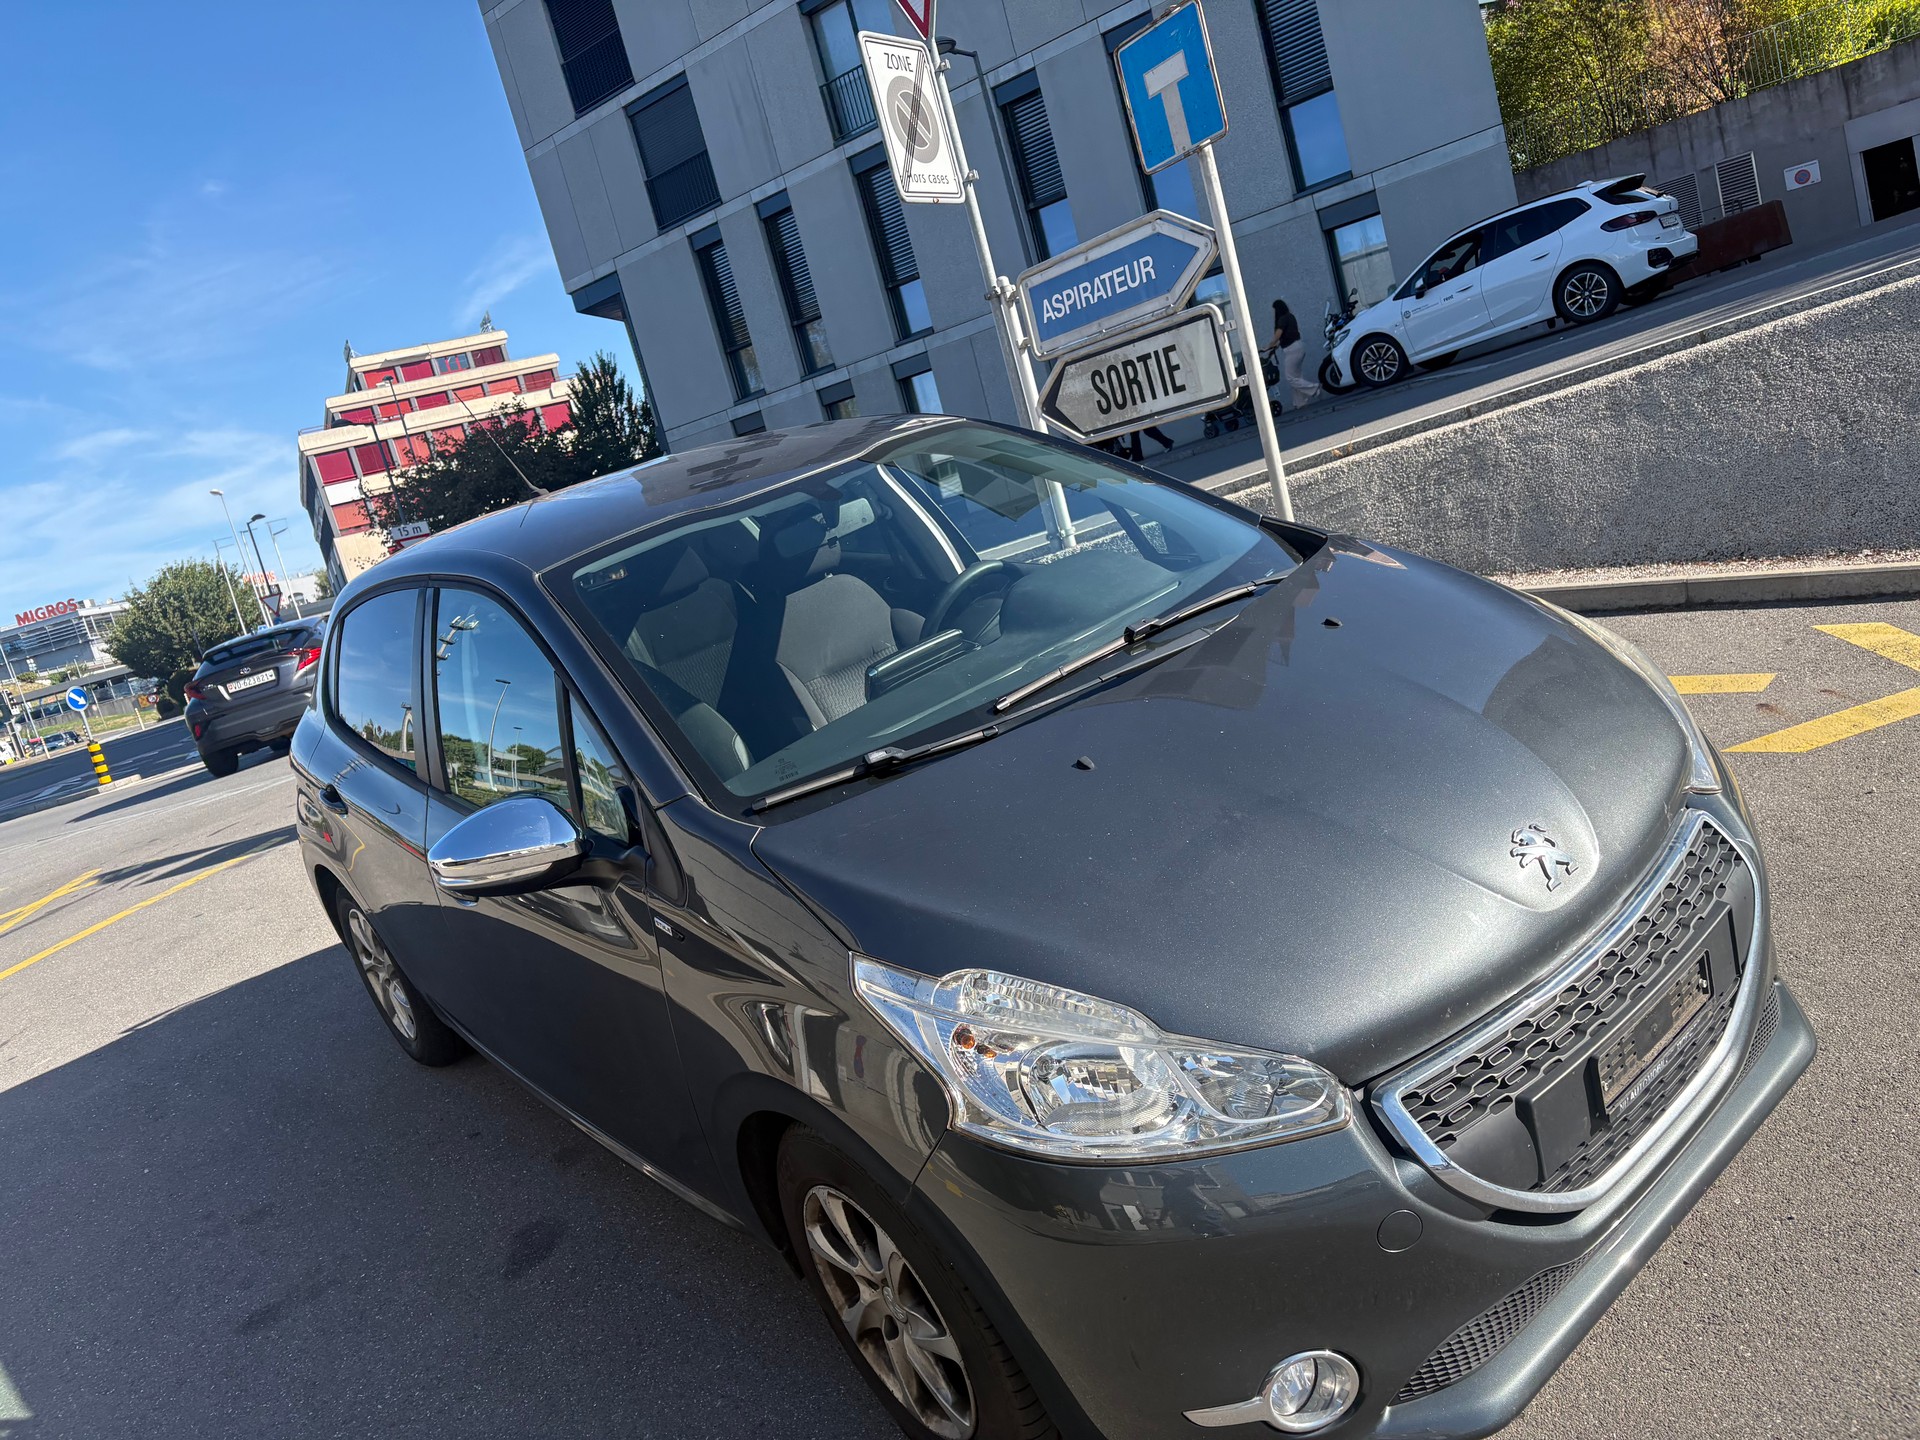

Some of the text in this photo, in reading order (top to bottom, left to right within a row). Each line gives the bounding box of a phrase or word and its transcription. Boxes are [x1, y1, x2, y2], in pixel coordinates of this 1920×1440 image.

[884, 52, 914, 73] ZONE
[927, 173, 950, 185] cases
[1042, 255, 1156, 324] ASPIRATEUR
[1091, 344, 1187, 415] SORTIE
[397, 525, 422, 537] 15 m
[15, 598, 78, 626] MIGROS
